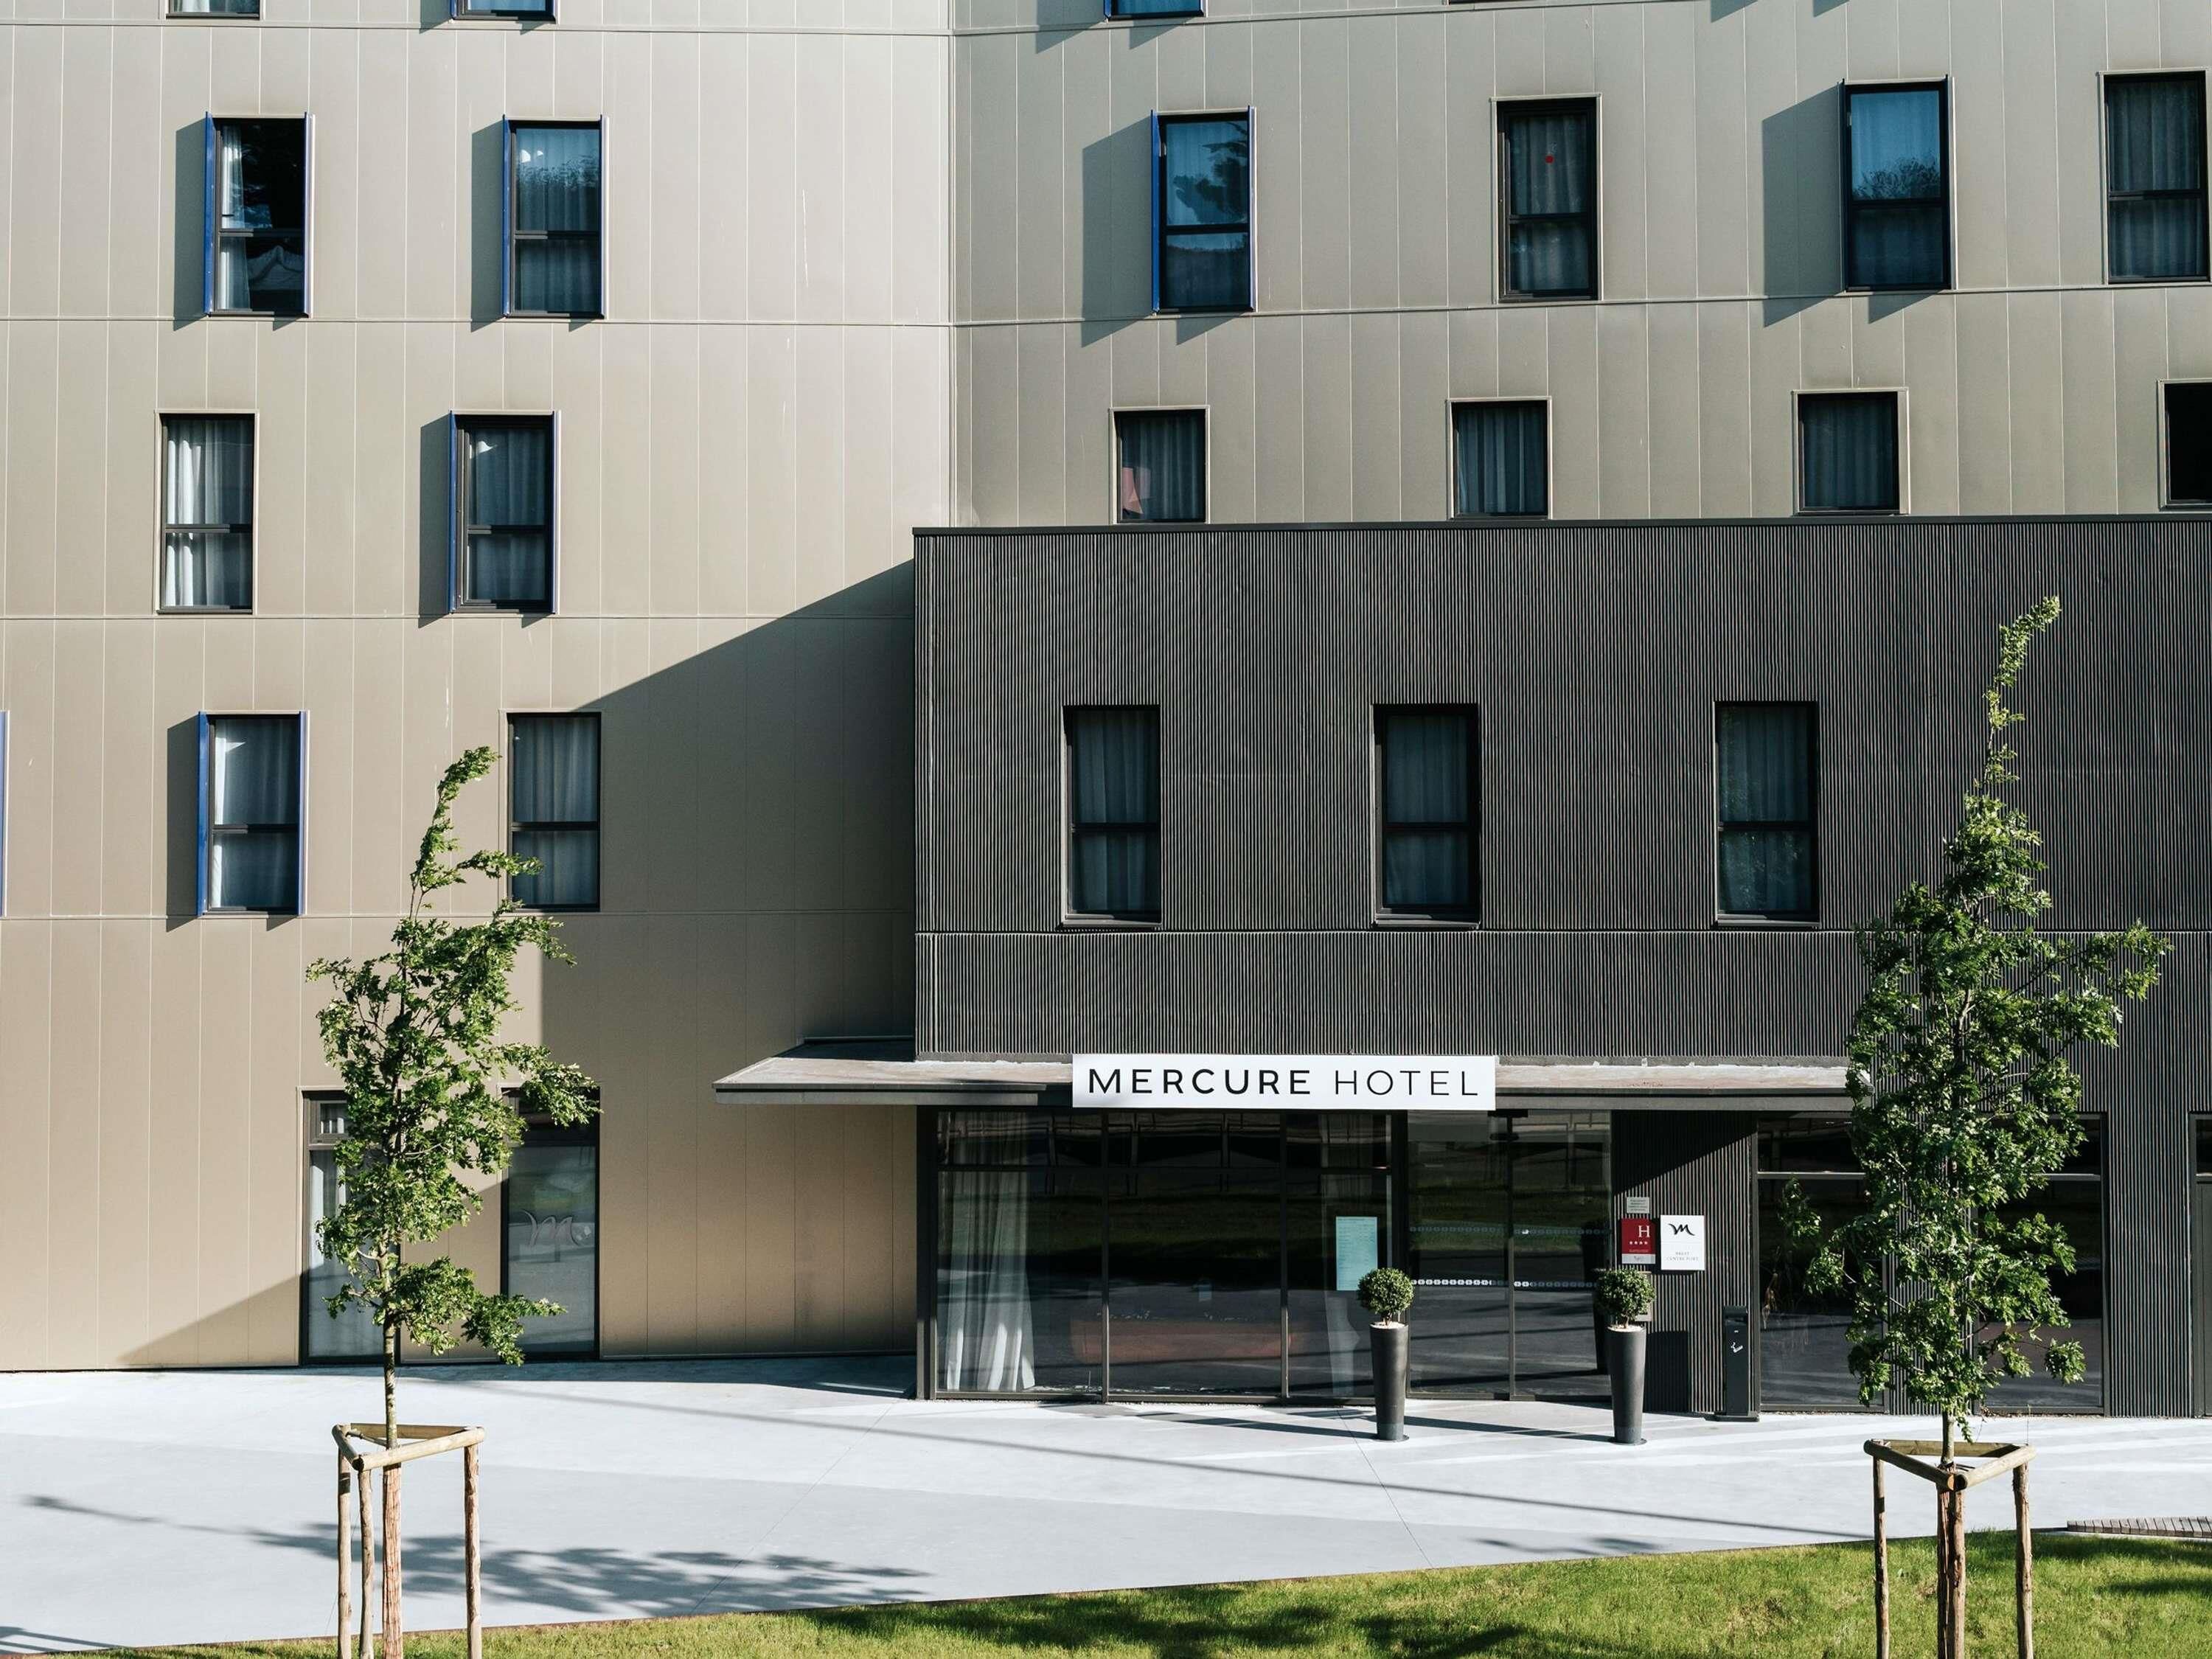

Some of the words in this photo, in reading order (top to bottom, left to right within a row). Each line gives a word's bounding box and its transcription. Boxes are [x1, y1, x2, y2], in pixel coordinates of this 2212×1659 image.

[1089, 1068, 1310, 1095] MERCURE
[1335, 1070, 1478, 1096] HOTEL
[1638, 1225, 1650, 1238] H
